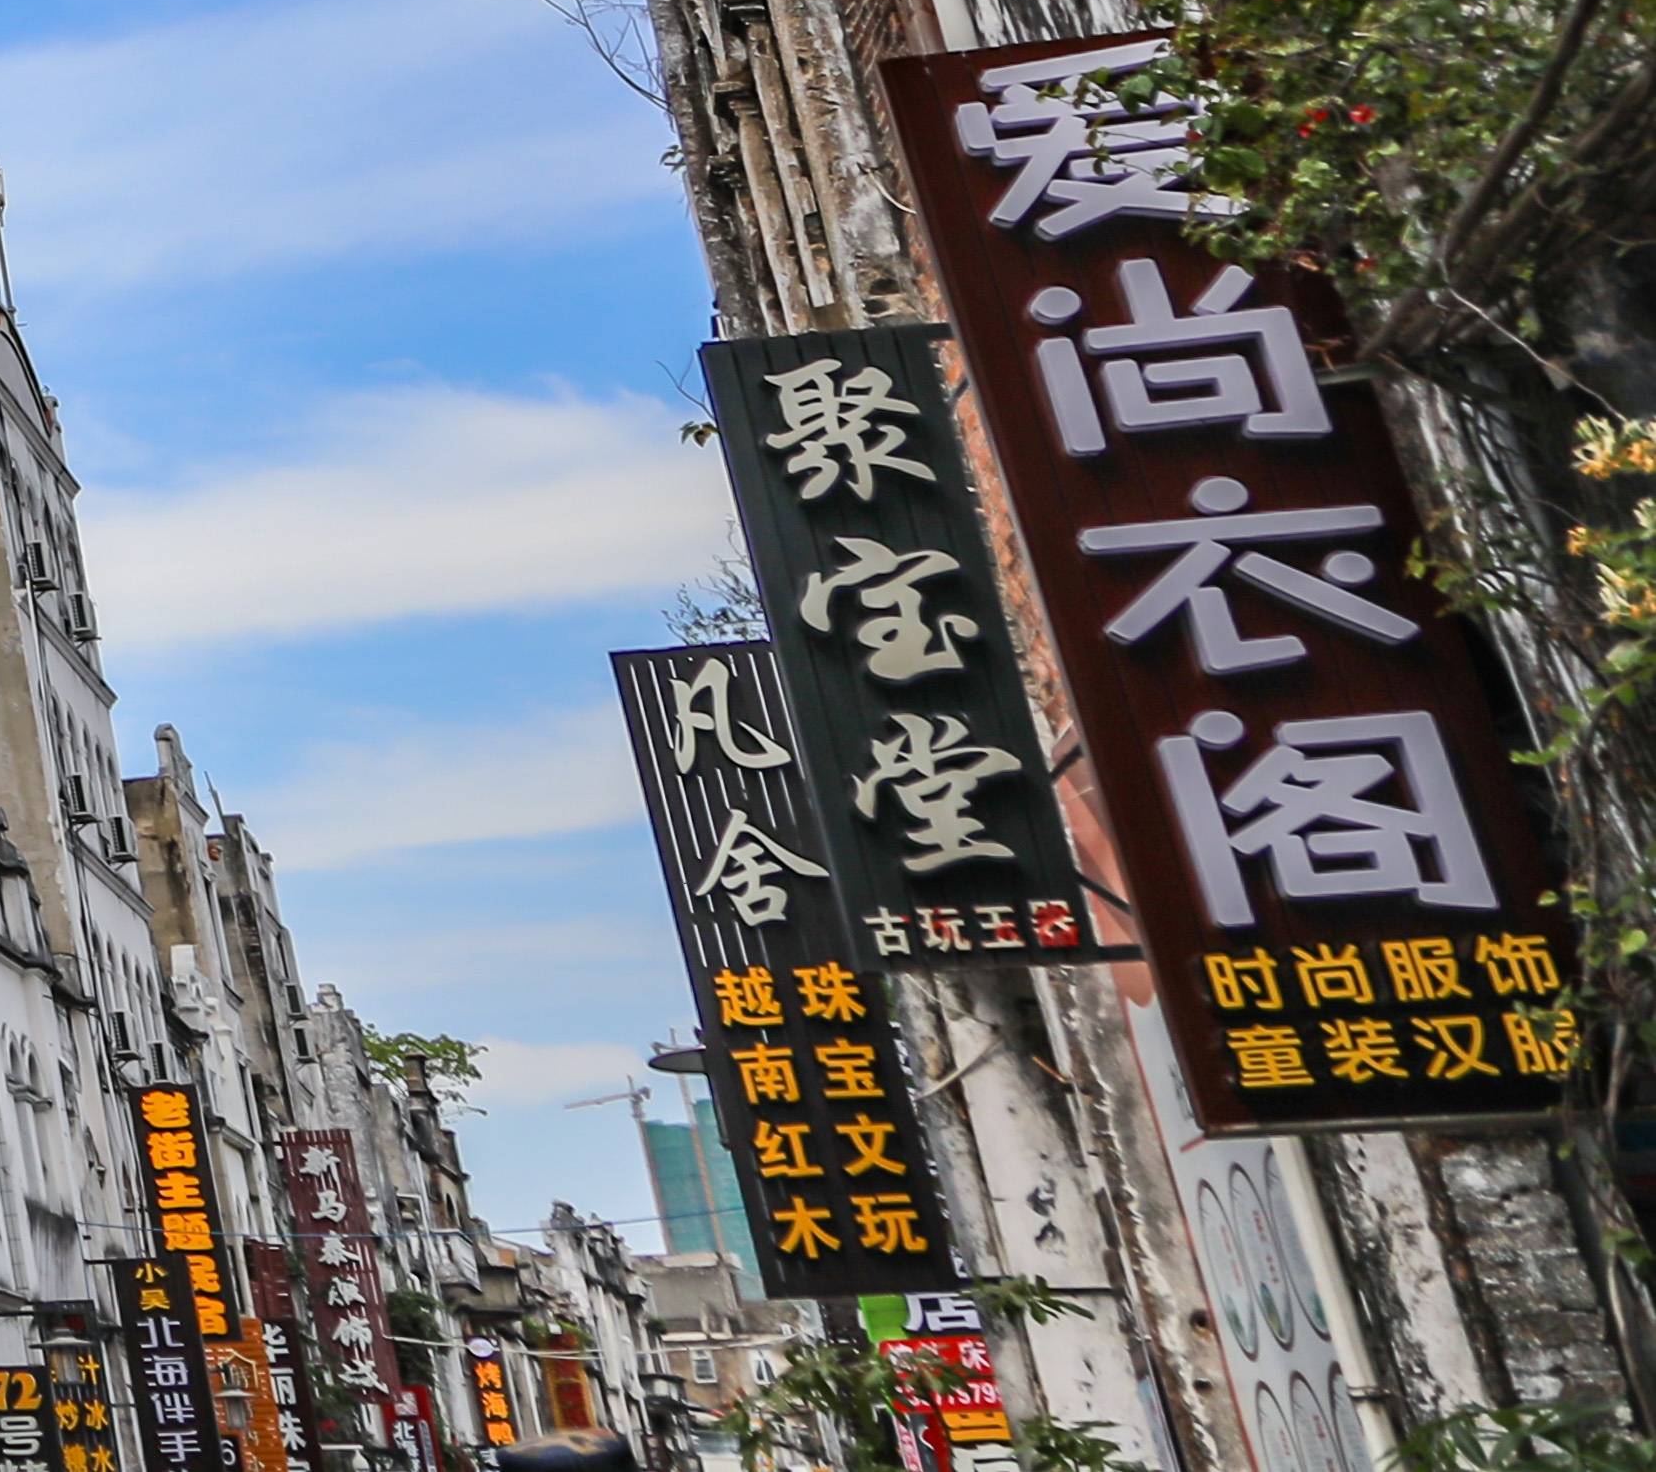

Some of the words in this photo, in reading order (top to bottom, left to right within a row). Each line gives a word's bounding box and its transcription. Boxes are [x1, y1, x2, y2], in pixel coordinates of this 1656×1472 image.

[764, 357, 1021, 876] 聚宝堂
[957, 39, 1499, 928] 爱尚衣阁
[864, 901, 1083, 962] 古玩玉器
[1205, 933, 1563, 1013] 时尚服饰
[1227, 1010, 1586, 1090] 童装汉服
[714, 966, 839, 1260] 越南红木
[798, 962, 928, 1254] 珠宝文玩
